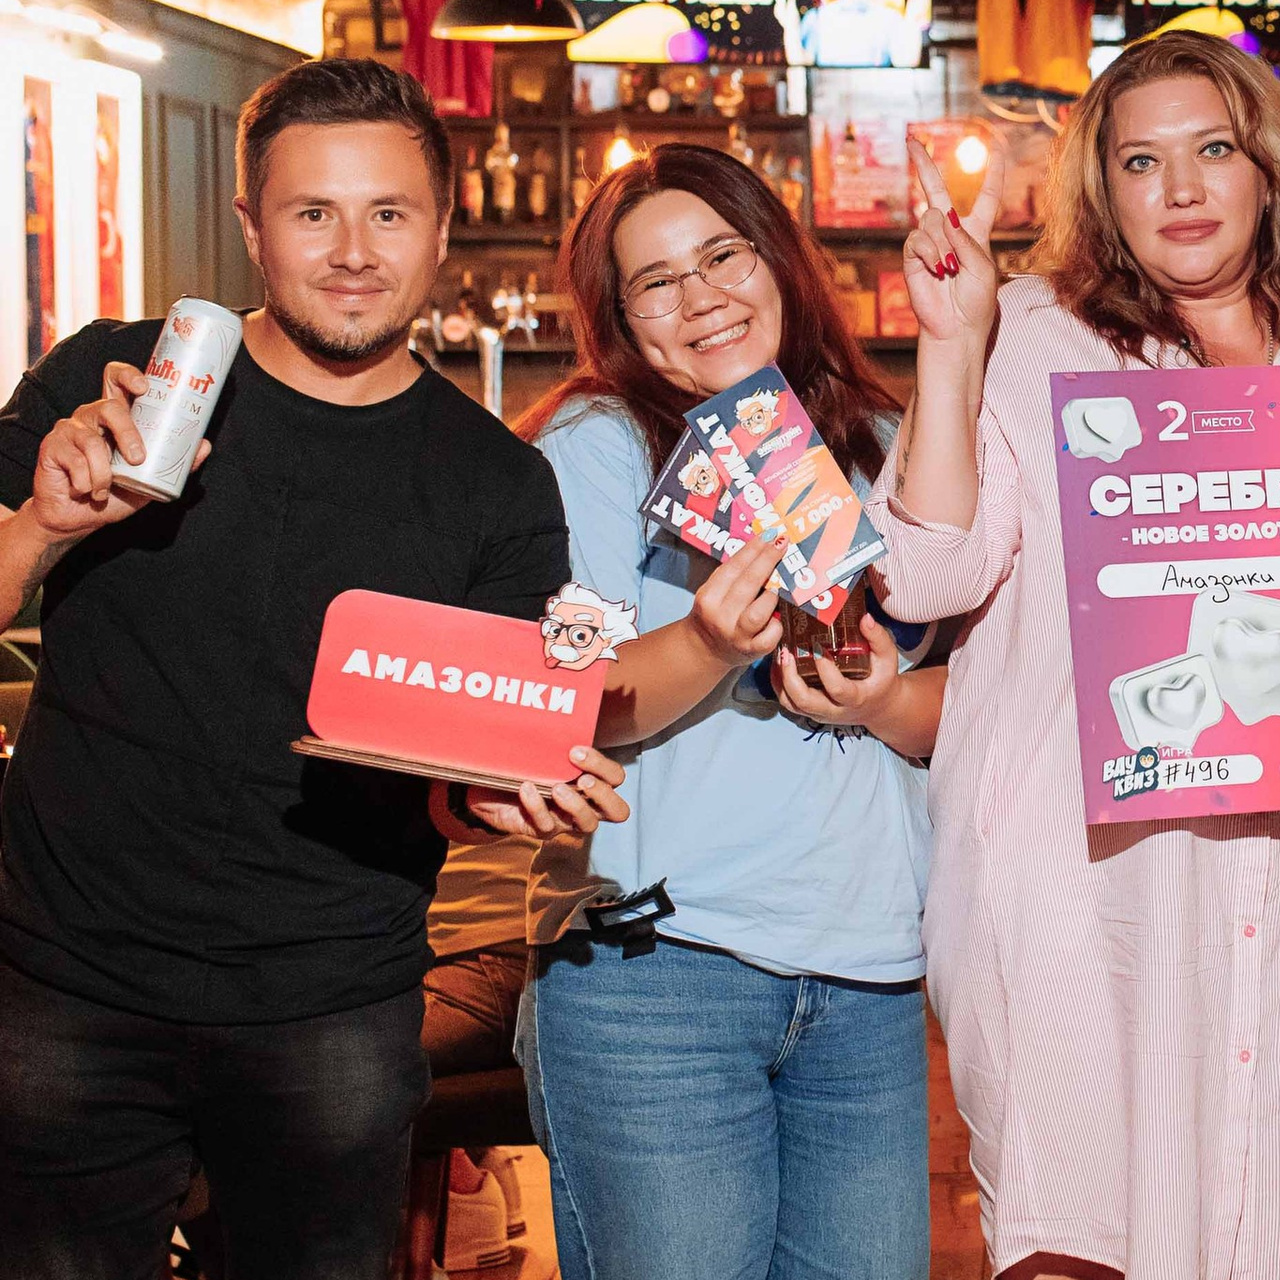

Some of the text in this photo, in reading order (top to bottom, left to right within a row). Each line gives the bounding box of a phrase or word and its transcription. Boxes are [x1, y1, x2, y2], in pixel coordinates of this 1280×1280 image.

[1157, 401, 1242, 441] 2 МЕСТО
[1132, 524, 1210, 545] НОВОЕ
[1161, 565, 1275, 602] Амазонки
[341, 649, 577, 714] АМАЗОНКИ
[1162, 748, 1193, 757] ИГРА
[1114, 771, 1155, 797] КВИЗ
[1164, 758, 1229, 784] #496
